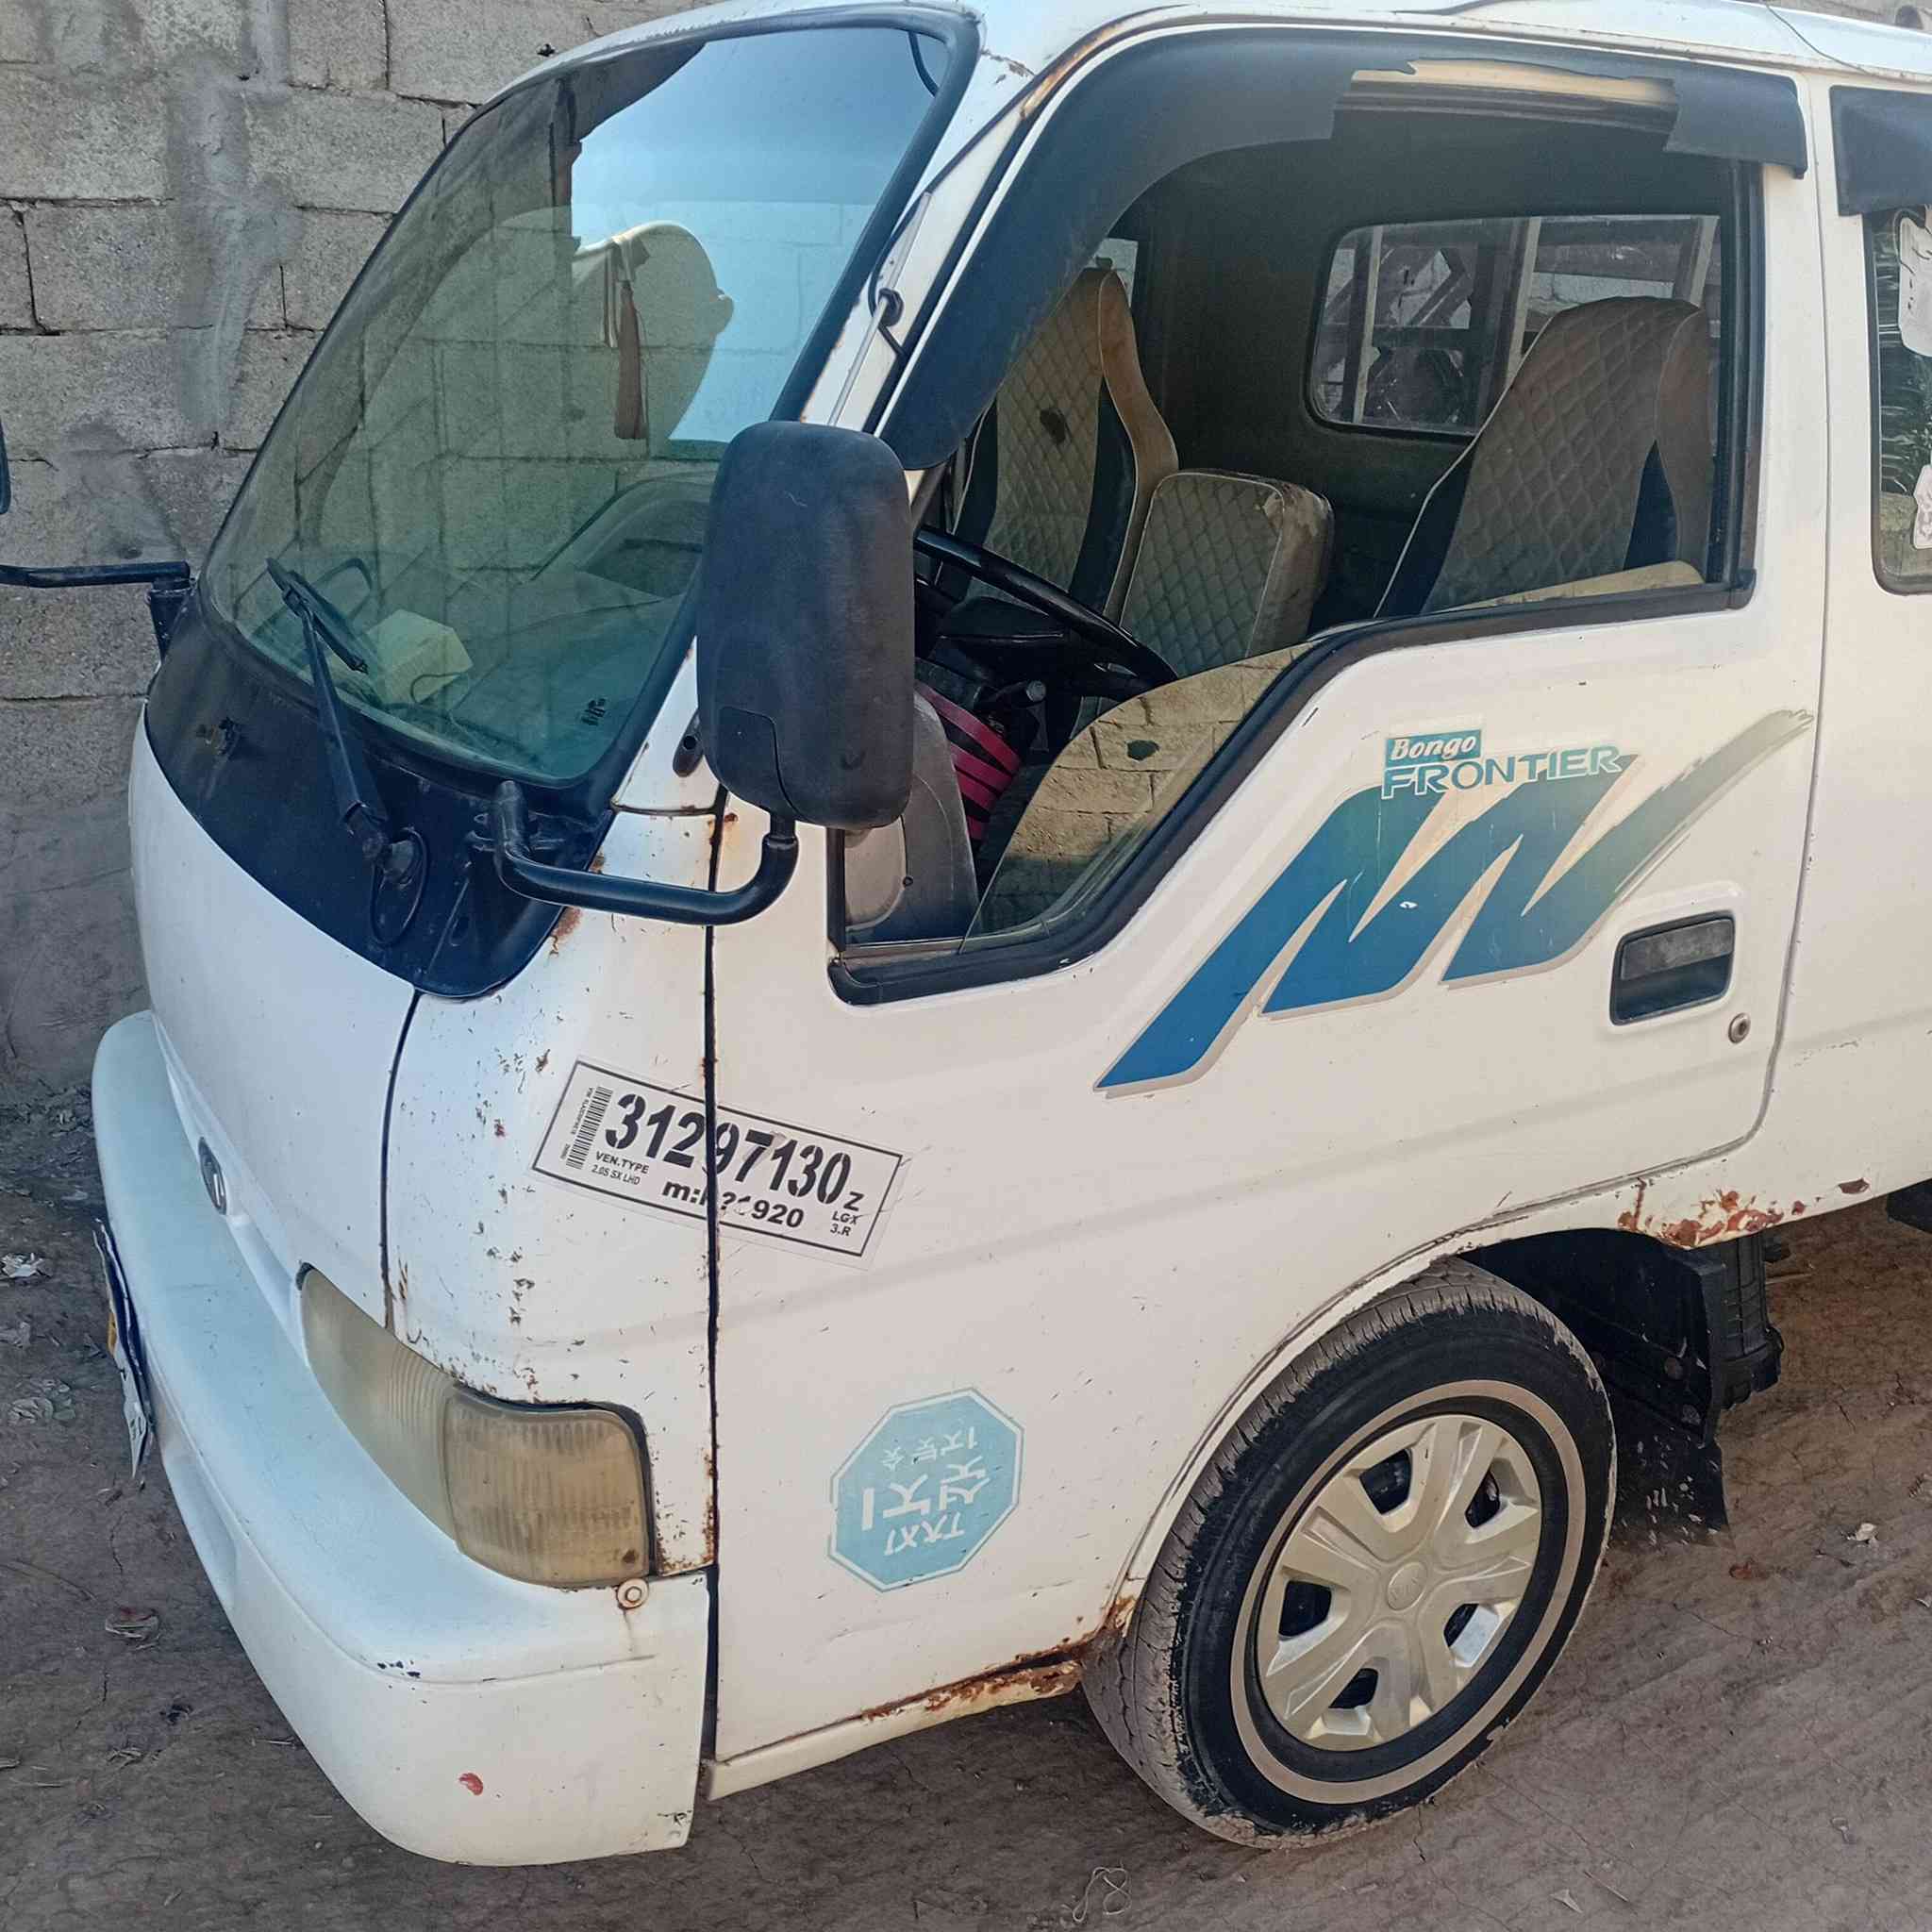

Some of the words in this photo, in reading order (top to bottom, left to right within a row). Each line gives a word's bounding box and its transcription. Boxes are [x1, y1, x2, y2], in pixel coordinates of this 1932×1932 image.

[1390, 735, 1477, 761] Bongo
[1381, 744, 1624, 800] FRONTIER
[605, 1093, 850, 1205] 31297130
[843, 1191, 865, 1211] Z
